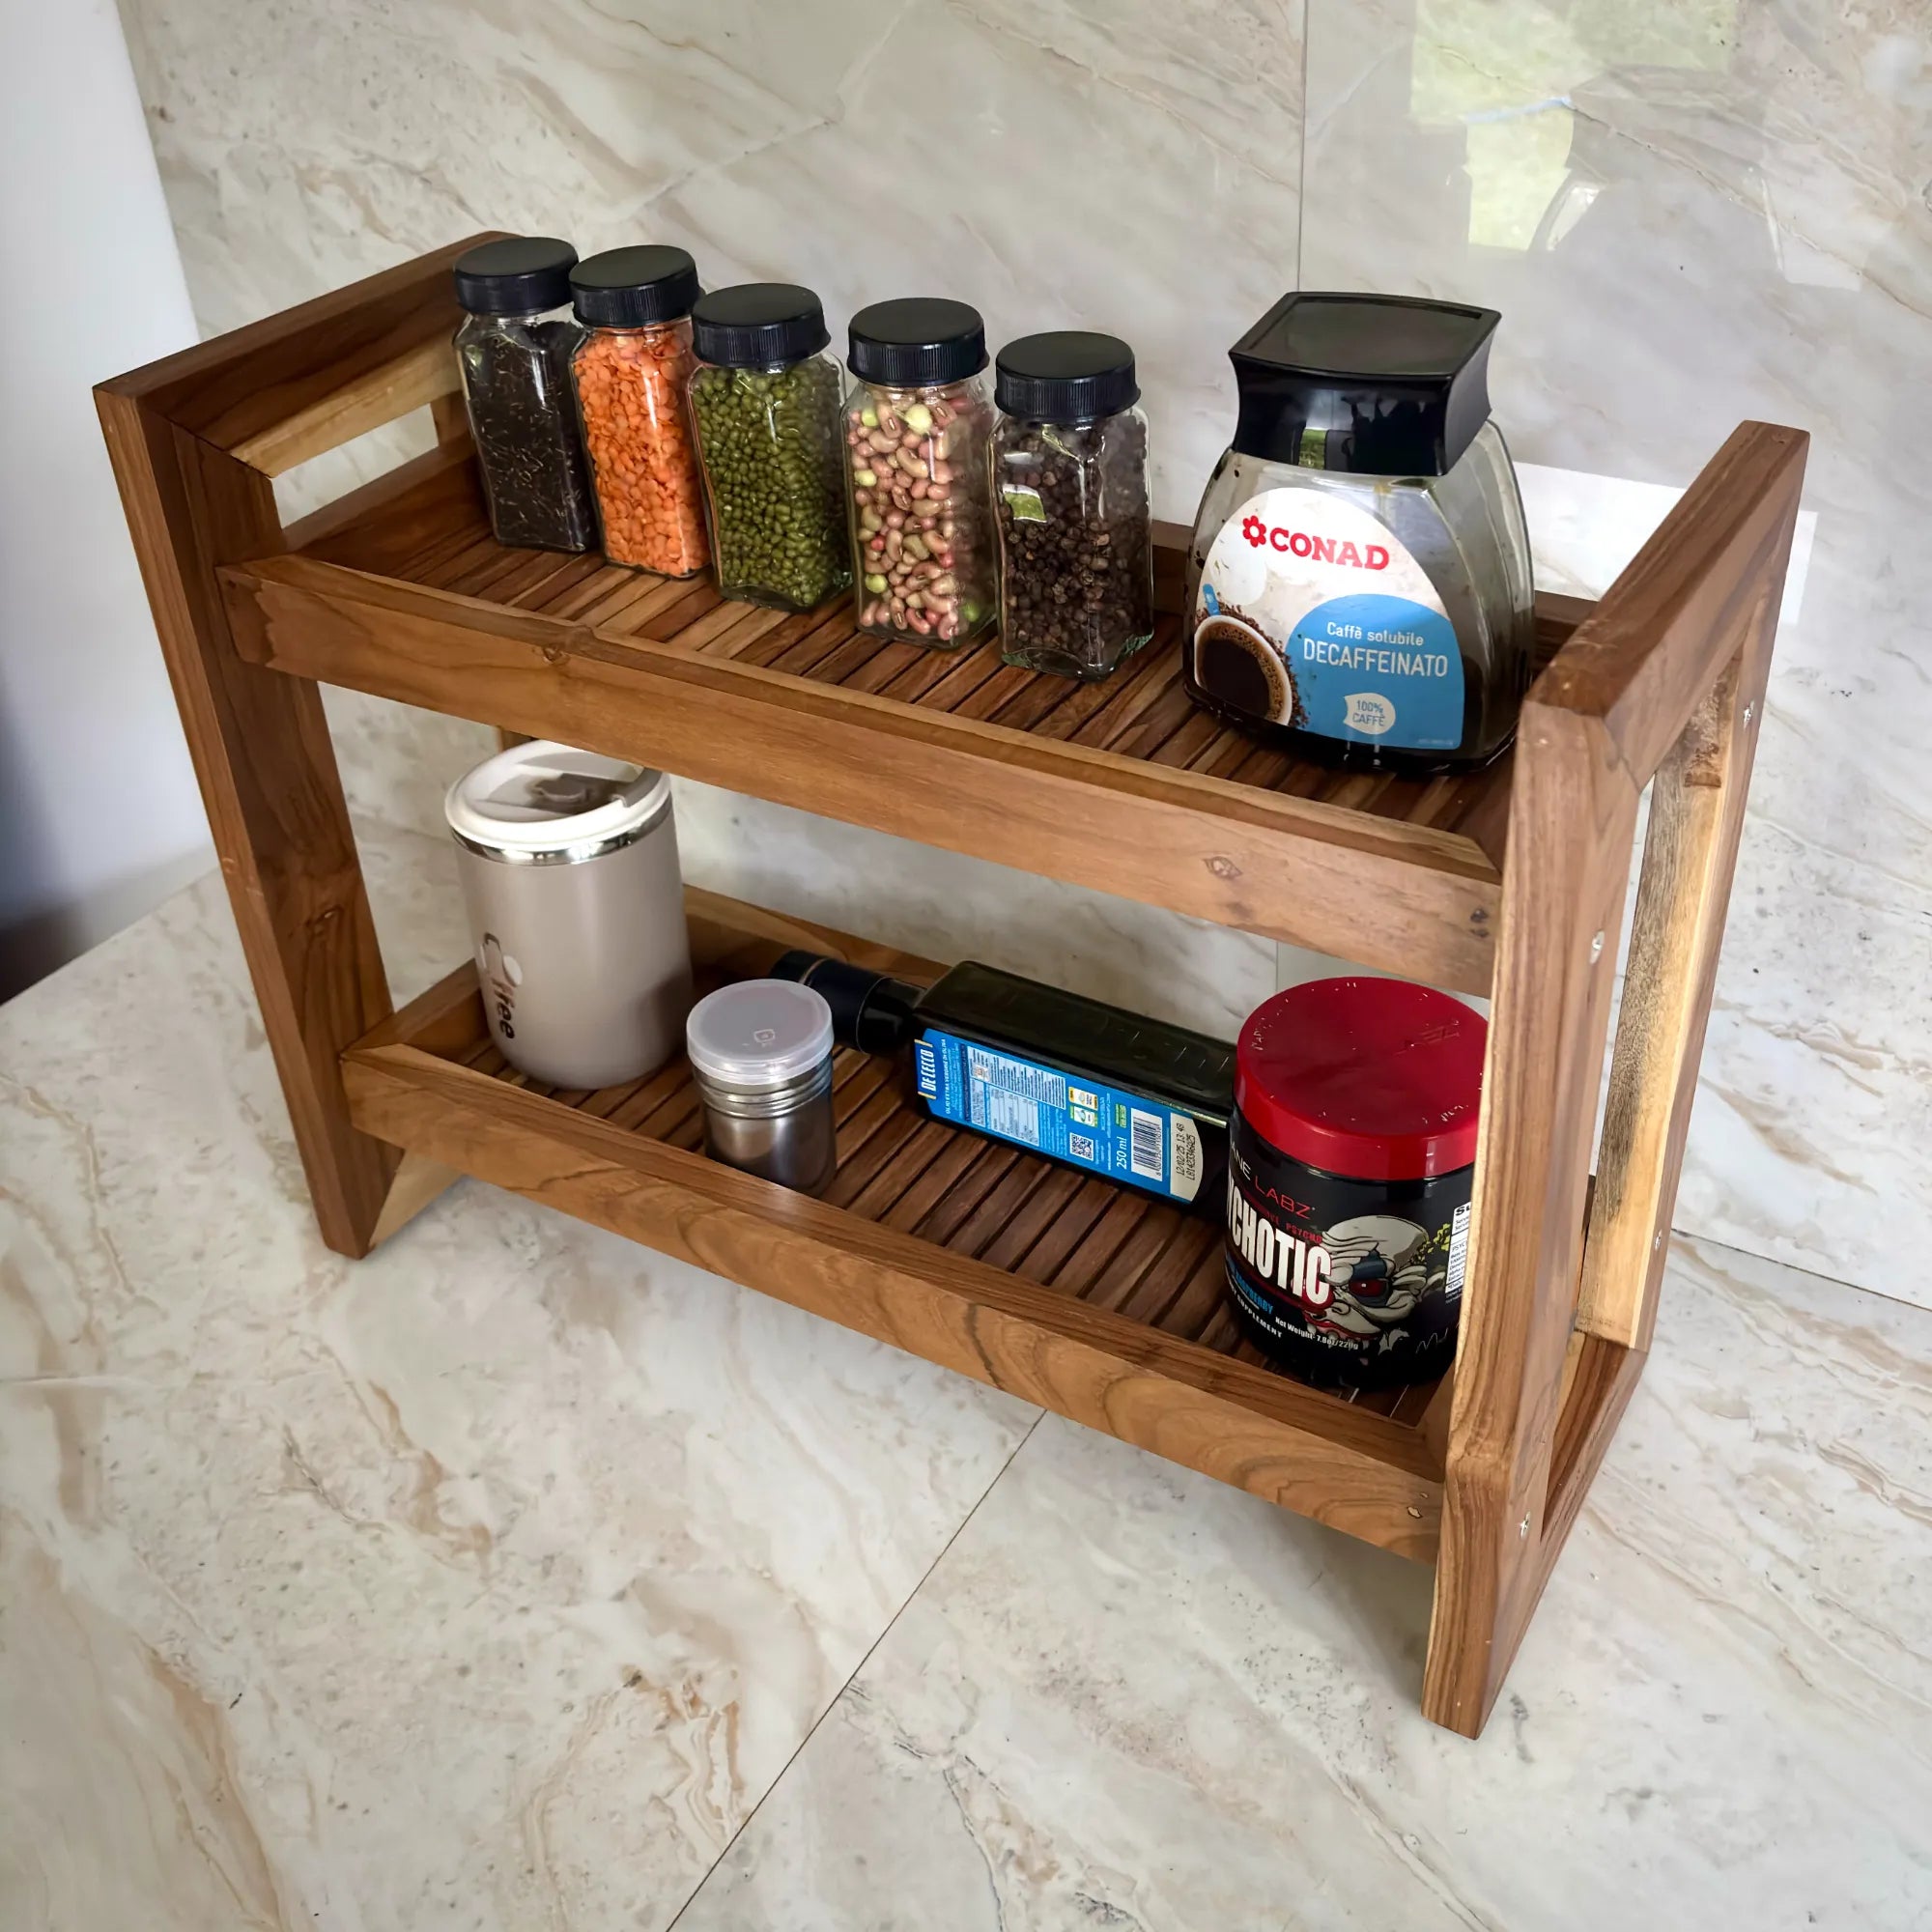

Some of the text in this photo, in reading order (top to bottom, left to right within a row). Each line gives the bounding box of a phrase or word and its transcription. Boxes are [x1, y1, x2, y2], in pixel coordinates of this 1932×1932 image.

[1269, 526, 1389, 570] CONAD
[1326, 621, 1424, 647] Caffè solubile
[1304, 638, 1448, 677] DECAFFEINATO
[1356, 699, 1384, 713] 100%
[1116, 1136, 1127, 1151] ml
[1116, 1151, 1127, 1170] 250
[1255, 1175, 1311, 1220] LABZ
[1275, 1316, 1287, 1328] Net
